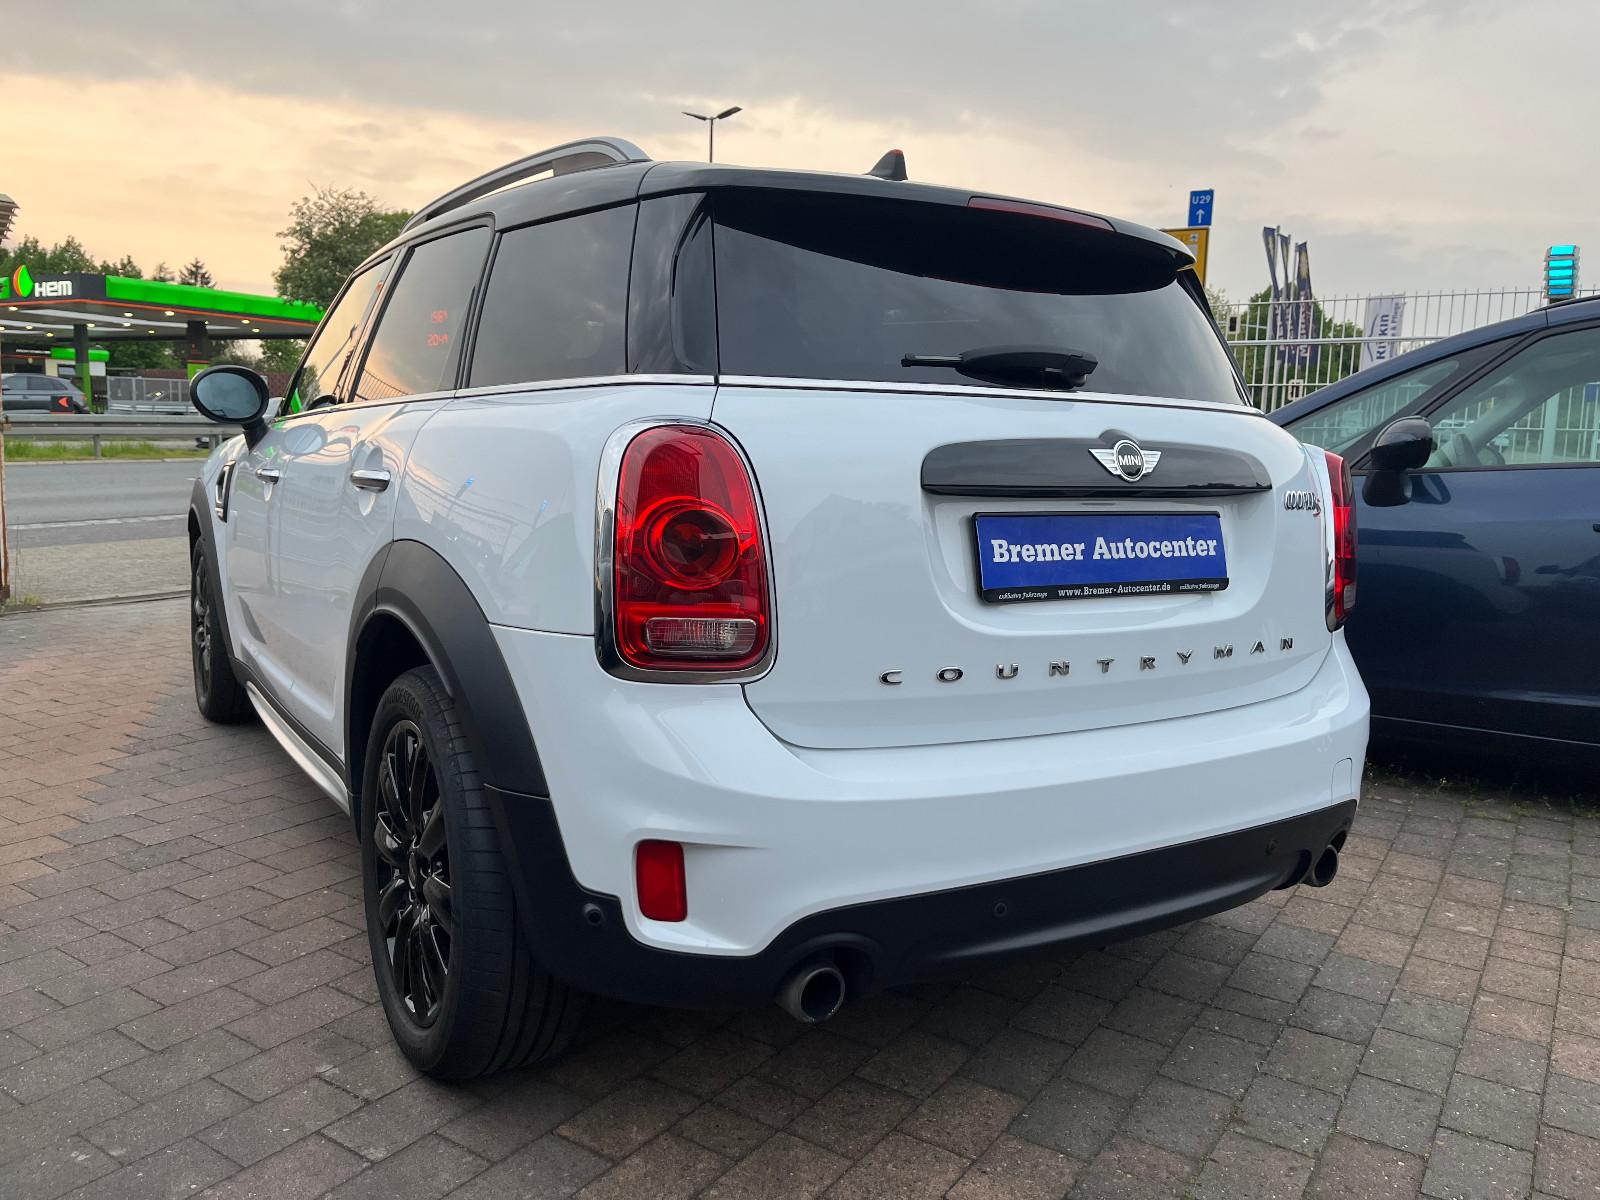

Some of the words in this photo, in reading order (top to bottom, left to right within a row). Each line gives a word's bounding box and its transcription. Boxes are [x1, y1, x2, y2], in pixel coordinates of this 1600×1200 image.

[1118, 454, 1142, 466] MINI
[991, 538, 1085, 563] Bremer
[1092, 536, 1217, 560] Autocenter
[1057, 582, 1171, 597] www.Bremer-Autocenter.de
[878, 636, 1294, 686] COUNTRYMAN
